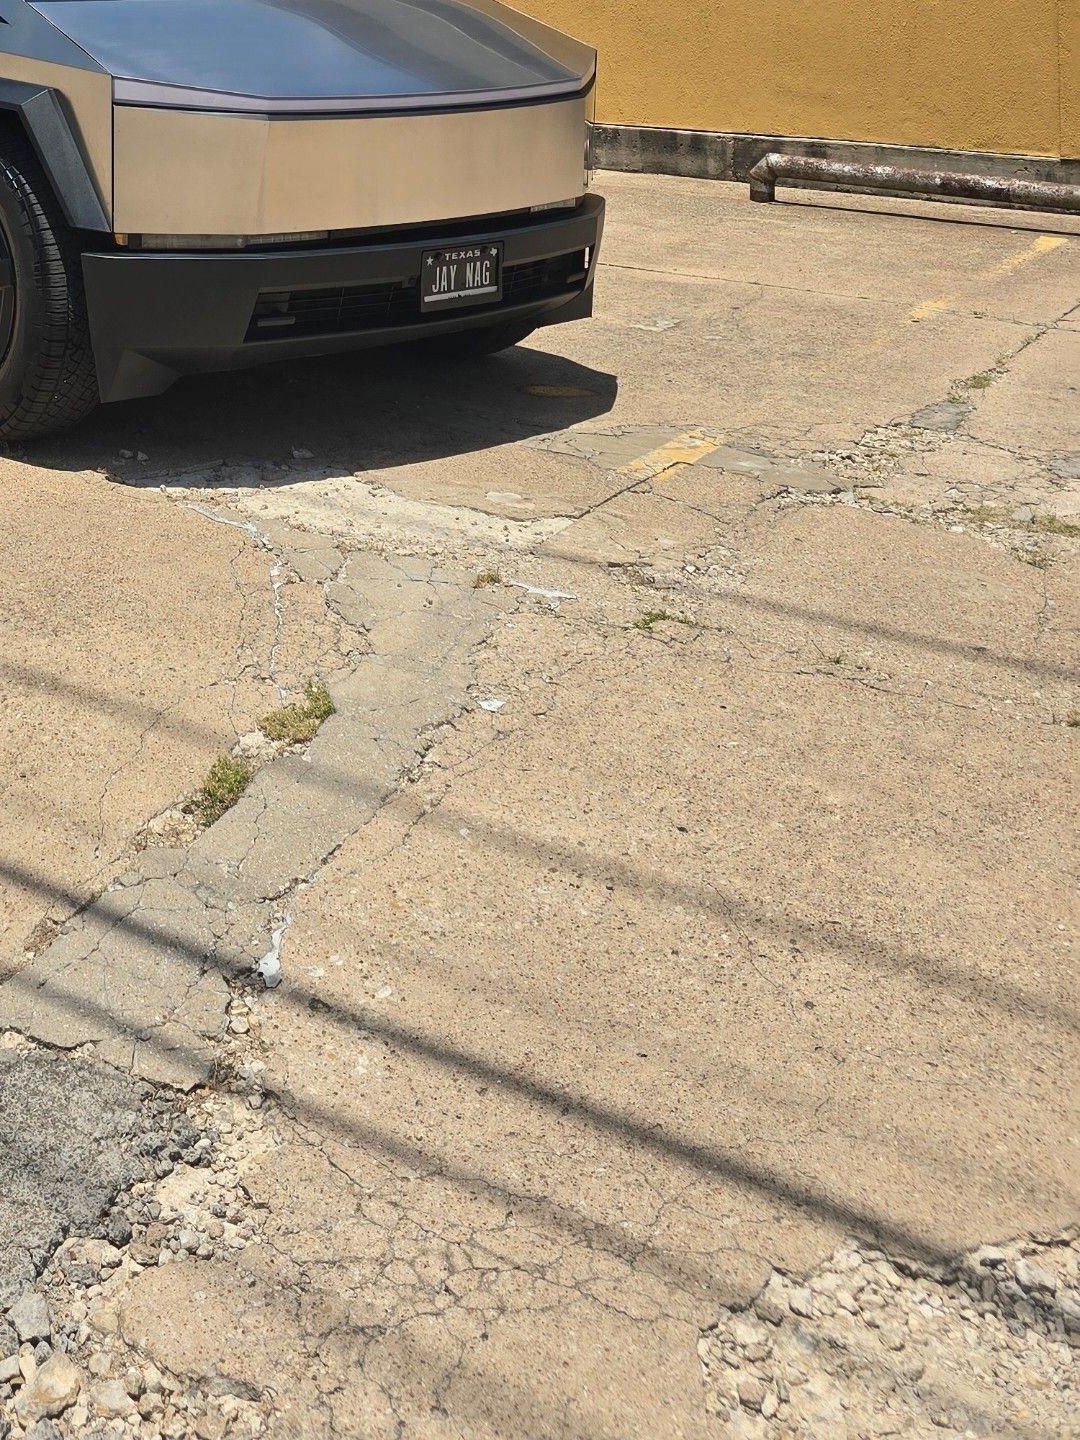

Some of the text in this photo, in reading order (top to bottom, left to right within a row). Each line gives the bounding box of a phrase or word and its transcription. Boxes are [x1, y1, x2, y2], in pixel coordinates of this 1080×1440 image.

[445, 249, 481, 261] TEXAS
[432, 260, 490, 293] JAY NAG
